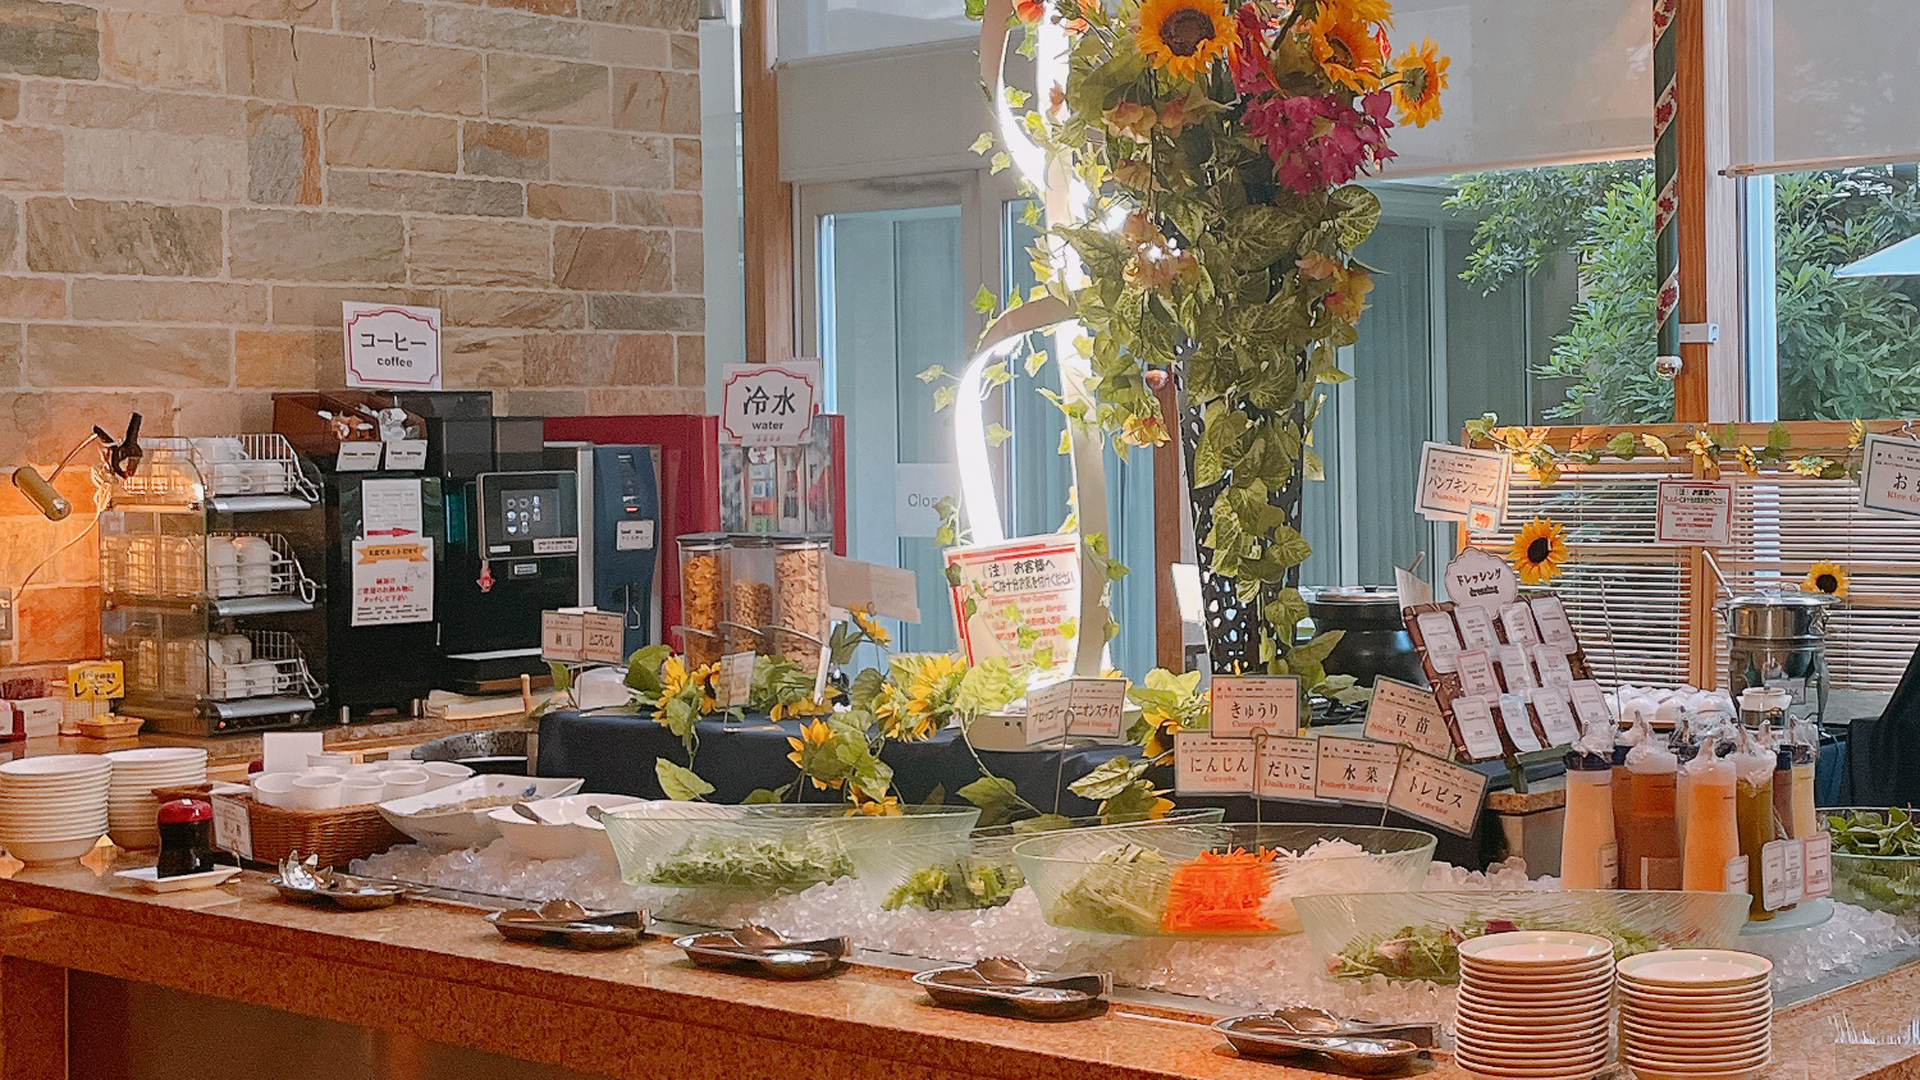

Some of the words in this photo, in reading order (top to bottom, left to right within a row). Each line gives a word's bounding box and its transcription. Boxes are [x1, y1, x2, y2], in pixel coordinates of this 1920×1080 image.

[360, 332, 427, 352] コーヒー
[377, 356, 413, 368] coffee
[743, 385, 796, 416] 冷水
[752, 420, 785, 430] water
[1428, 474, 1496, 498] パンプキンスープ
[1887, 490, 1906, 500] Rice
[1456, 568, 1501, 587] ドレッシング
[1231, 700, 1279, 720] きゅうり
[1395, 709, 1431, 735] 豆苗
[1190, 757, 1249, 773] にんじん
[1267, 760, 1311, 780] だいこ
[1342, 763, 1379, 784] 水菜
[1263, 778, 1296, 789] Daikon
[1409, 775, 1463, 808] トレビス
